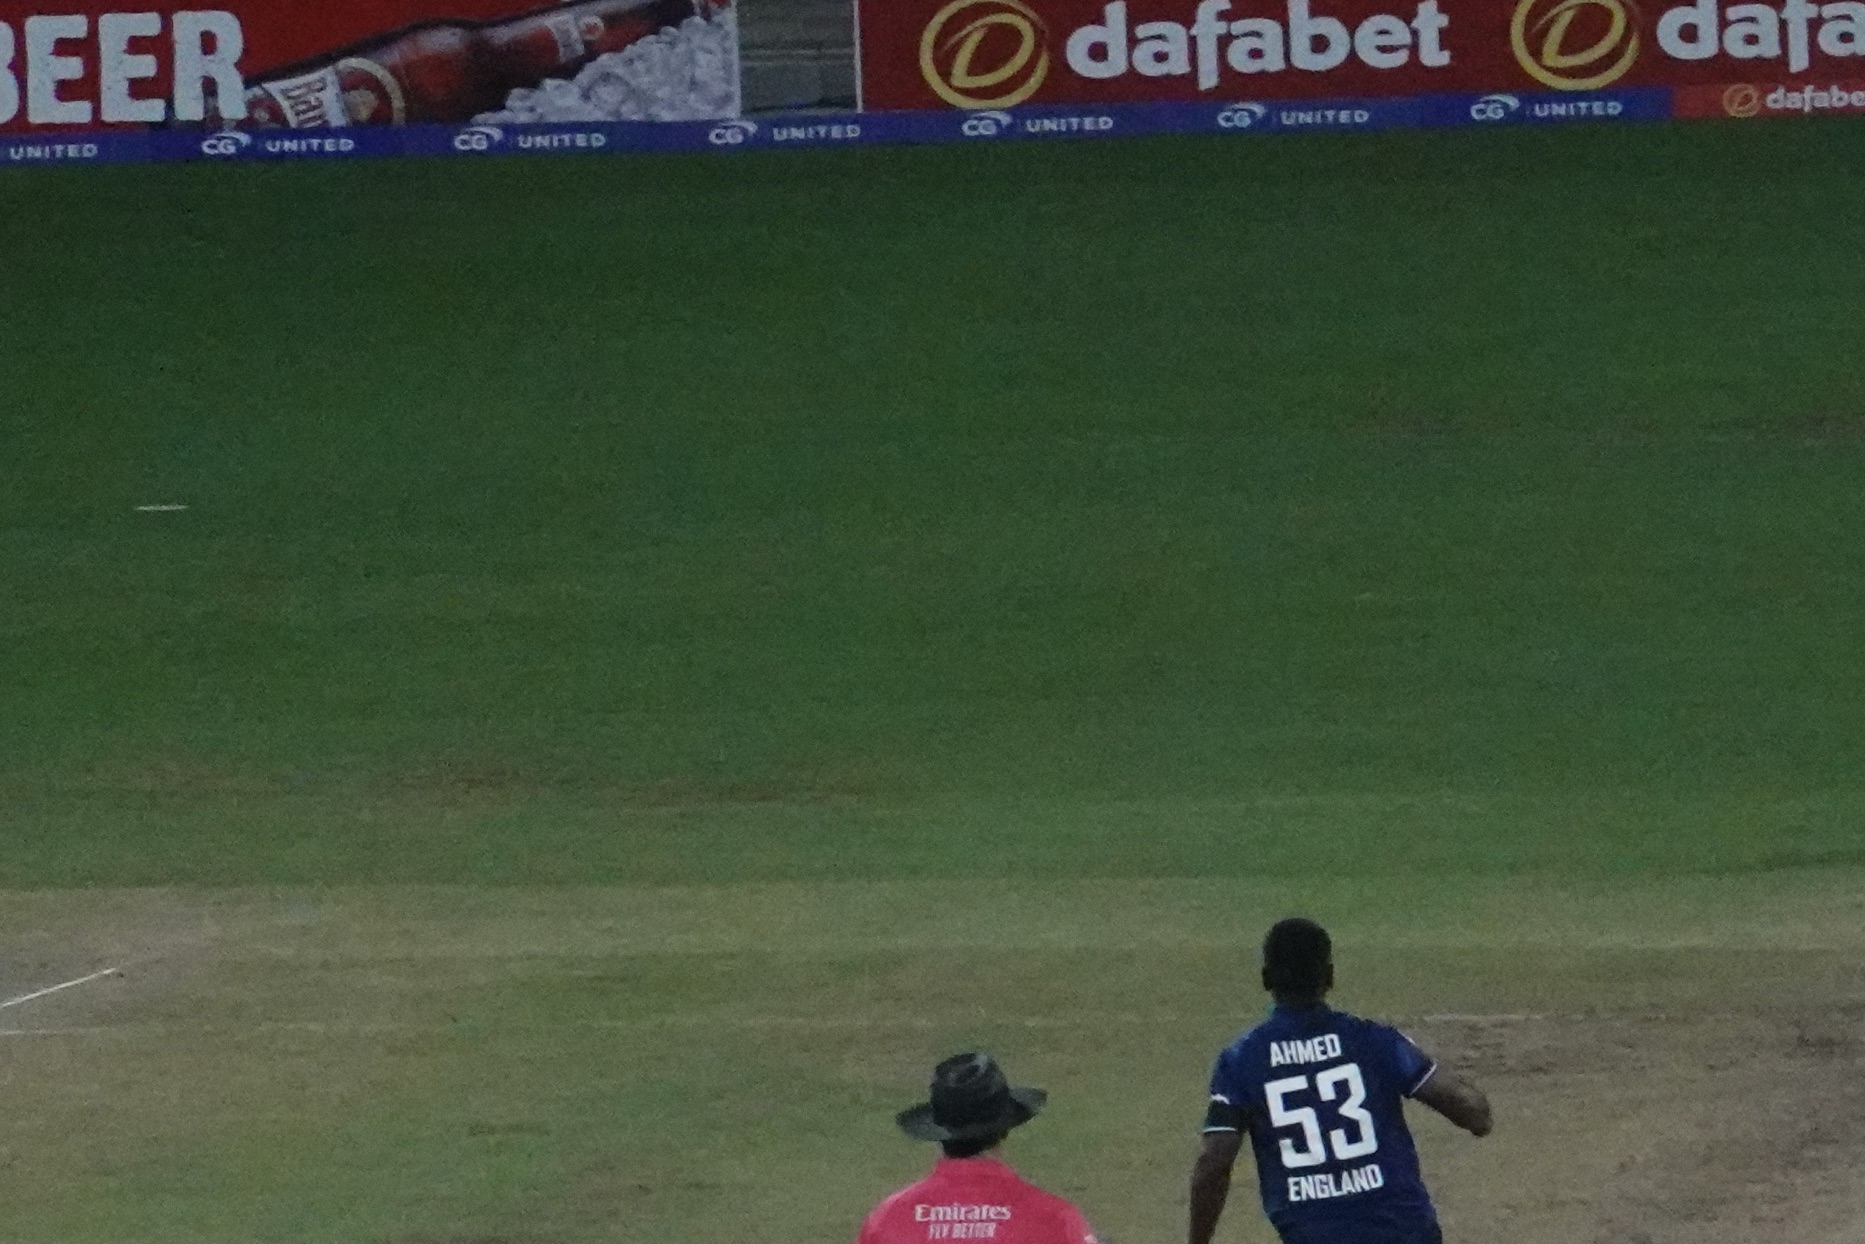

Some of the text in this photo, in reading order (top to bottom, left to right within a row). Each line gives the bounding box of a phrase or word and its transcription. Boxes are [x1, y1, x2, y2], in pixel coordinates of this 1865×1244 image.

[1066, 0, 1450, 90] dafabet
[0, 11, 247, 125] EER
[1217, 110, 1369, 127] CG UNITED
[1471, 102, 1622, 120] CG UNITED
[709, 125, 860, 144] CG UNITED
[962, 117, 1113, 136] CG UNITED
[202, 136, 354, 154] CG UNITED
[454, 133, 605, 150] CG UNITED
[10, 144, 97, 160] UNITED
[1270, 1033, 1343, 1068] AHMED
[1263, 1062, 1379, 1169] 53
[1287, 1163, 1384, 1203] ENGLAND
[914, 1202, 1011, 1221] Emirates
